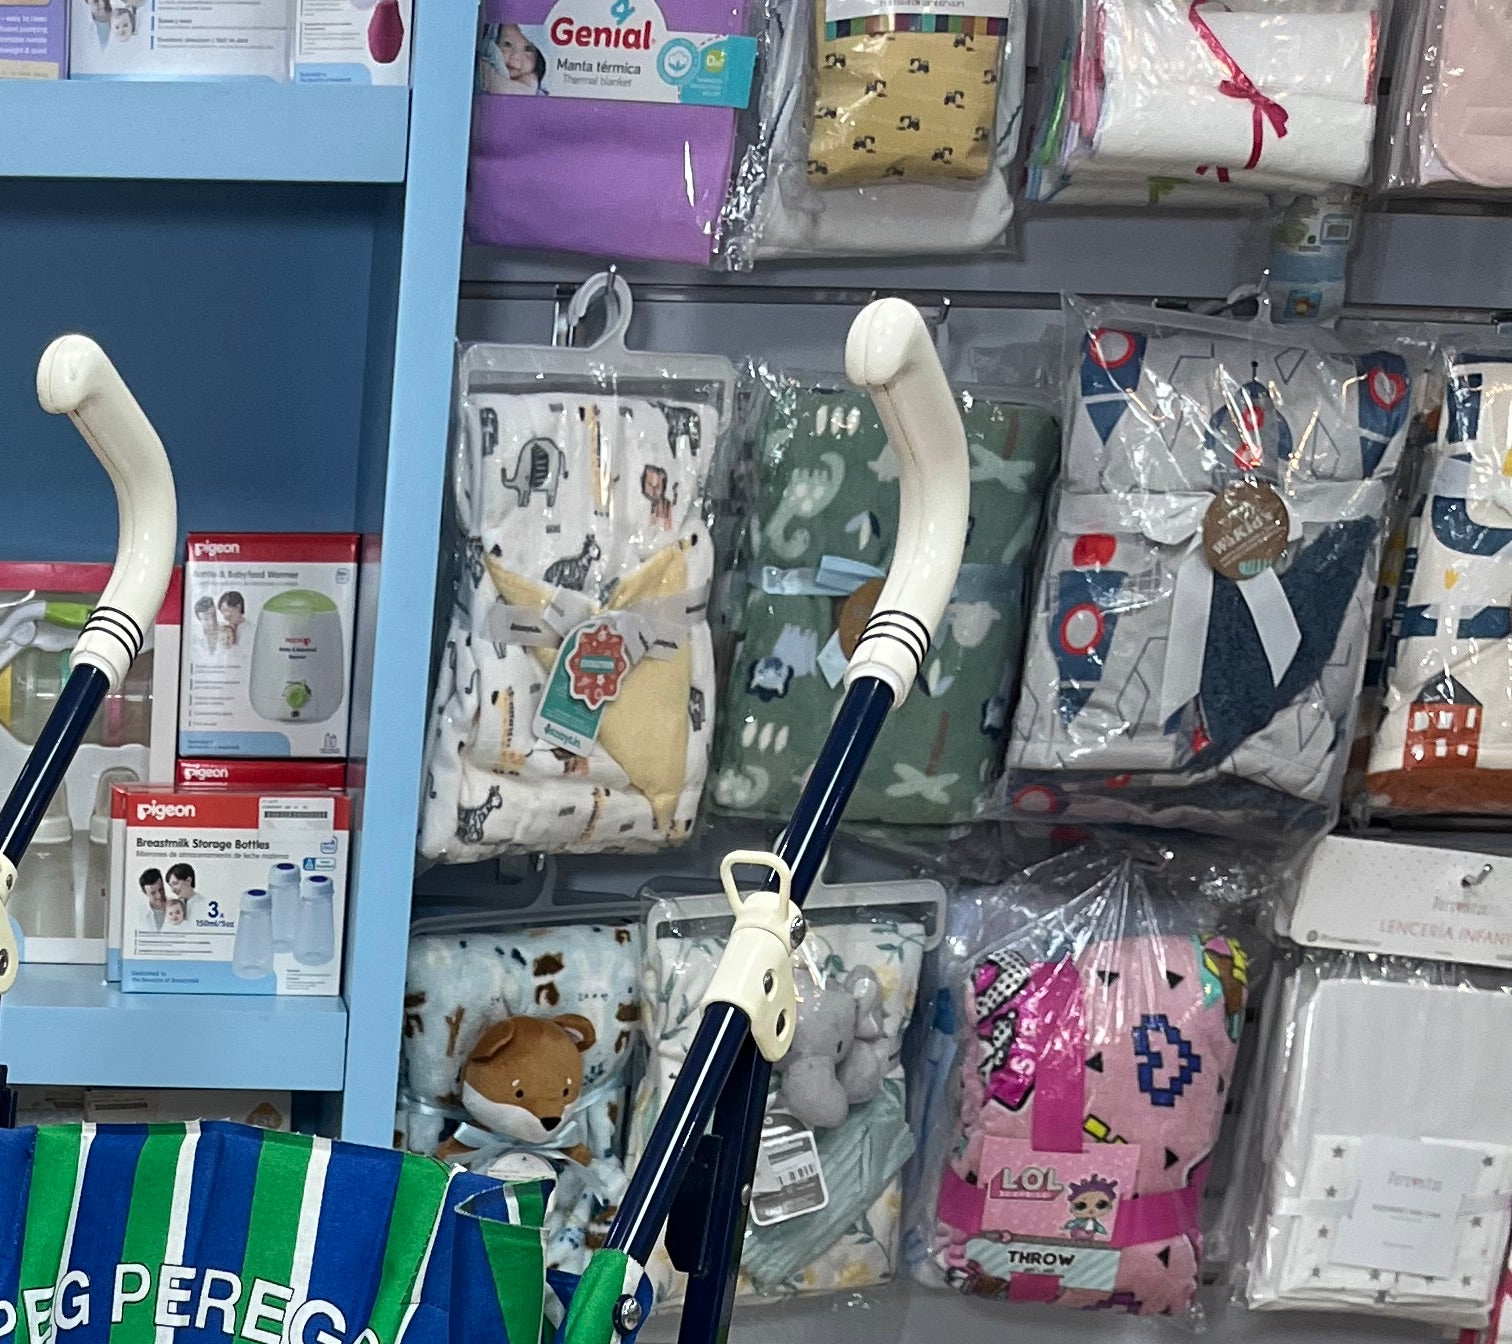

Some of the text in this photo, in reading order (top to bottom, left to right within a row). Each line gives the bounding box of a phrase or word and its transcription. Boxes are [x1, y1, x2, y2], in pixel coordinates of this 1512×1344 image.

[550, 16, 653, 51] Genial
[556, 58, 642, 75] Manta térmica
[194, 540, 241, 556] pigeon
[183, 764, 229, 780] pigeon
[137, 799, 196, 821] pigeon
[136, 837, 270, 851] Breastmilk Storage Bottles
[207, 900, 219, 918] 3
[1459, 926, 1512, 945] INFANT
[1007, 1250, 1076, 1266] THROW
